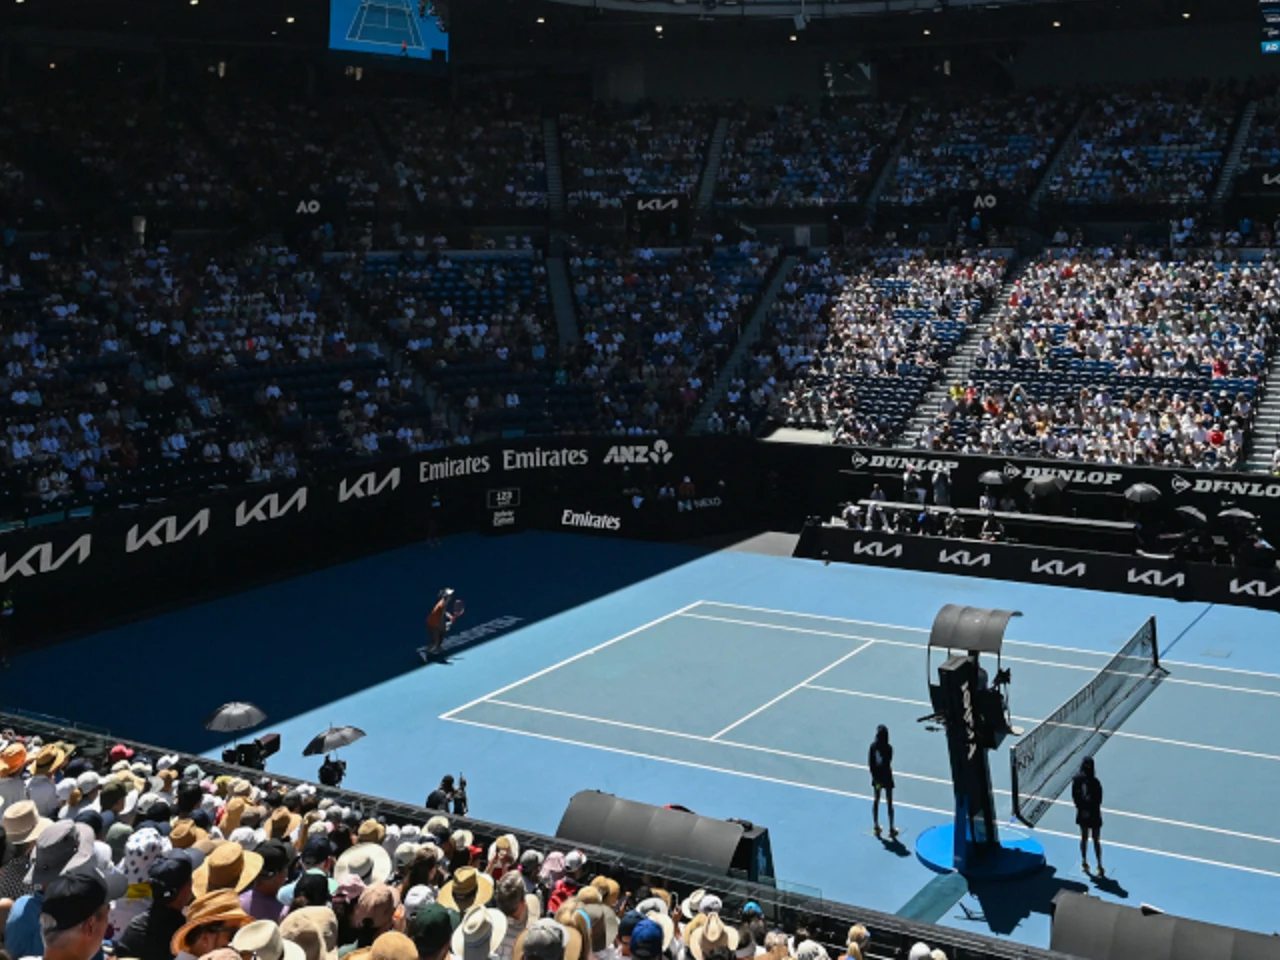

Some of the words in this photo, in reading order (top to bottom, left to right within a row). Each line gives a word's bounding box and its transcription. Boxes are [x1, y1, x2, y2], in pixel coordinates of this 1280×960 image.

[296, 200, 320, 213] AO
[973, 195, 997, 208] AO
[503, 448, 588, 469] Emirates
[604, 446, 651, 464] ANZ
[420, 456, 490, 482] Emirates
[339, 468, 400, 502] KIA
[236, 487, 307, 526] KIA
[562, 510, 620, 530] Emirates
[126, 508, 209, 552] KIA
[854, 541, 902, 557] KIA
[939, 550, 990, 566] KIA
[1032, 559, 1085, 576] KIA
[1128, 569, 1184, 586] KIA
